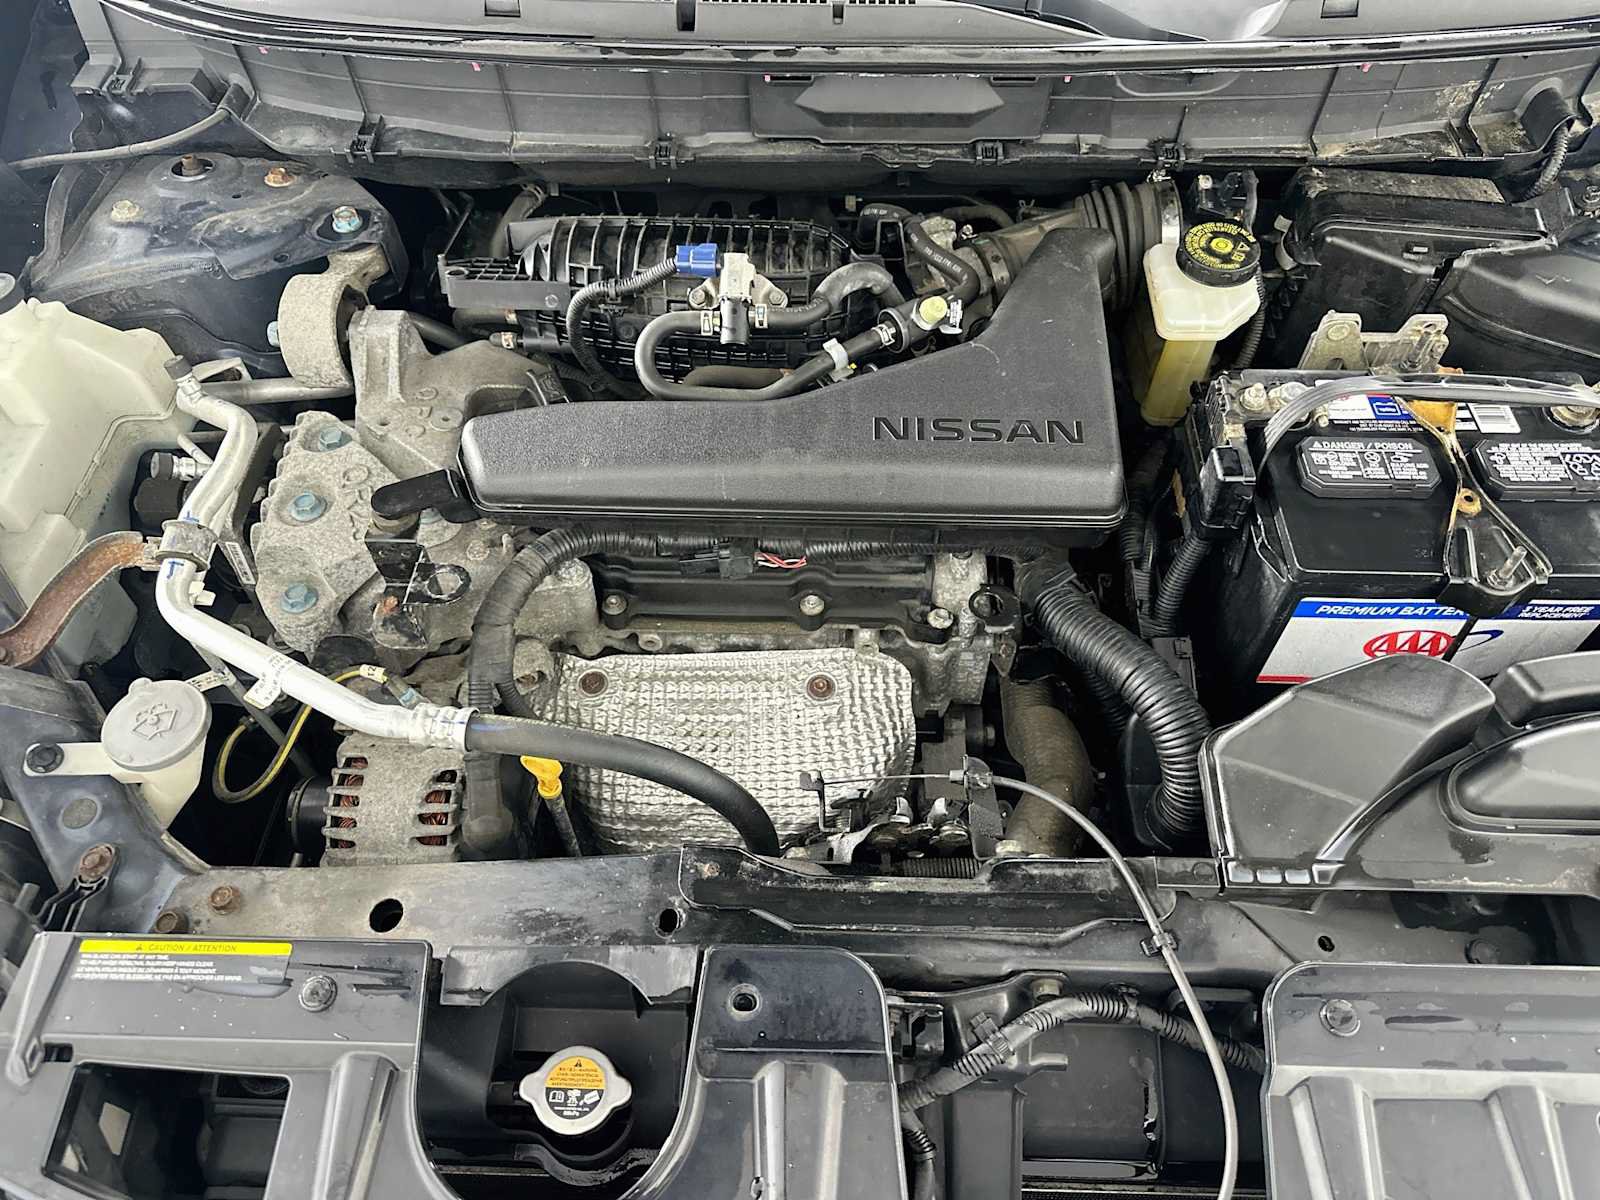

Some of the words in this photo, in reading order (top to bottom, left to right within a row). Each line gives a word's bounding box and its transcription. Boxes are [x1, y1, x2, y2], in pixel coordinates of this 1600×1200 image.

[872, 416, 1085, 445] NISSAN
[1322, 441, 1364, 450] DANGER
[1374, 442, 1413, 450] POISON
[1315, 605, 1398, 615] PREMIUM
[1399, 606, 1470, 616] BATTER
[1370, 630, 1447, 657] AAA
[149, 943, 185, 952] CAUTION
[192, 944, 237, 953] ATTENTION
